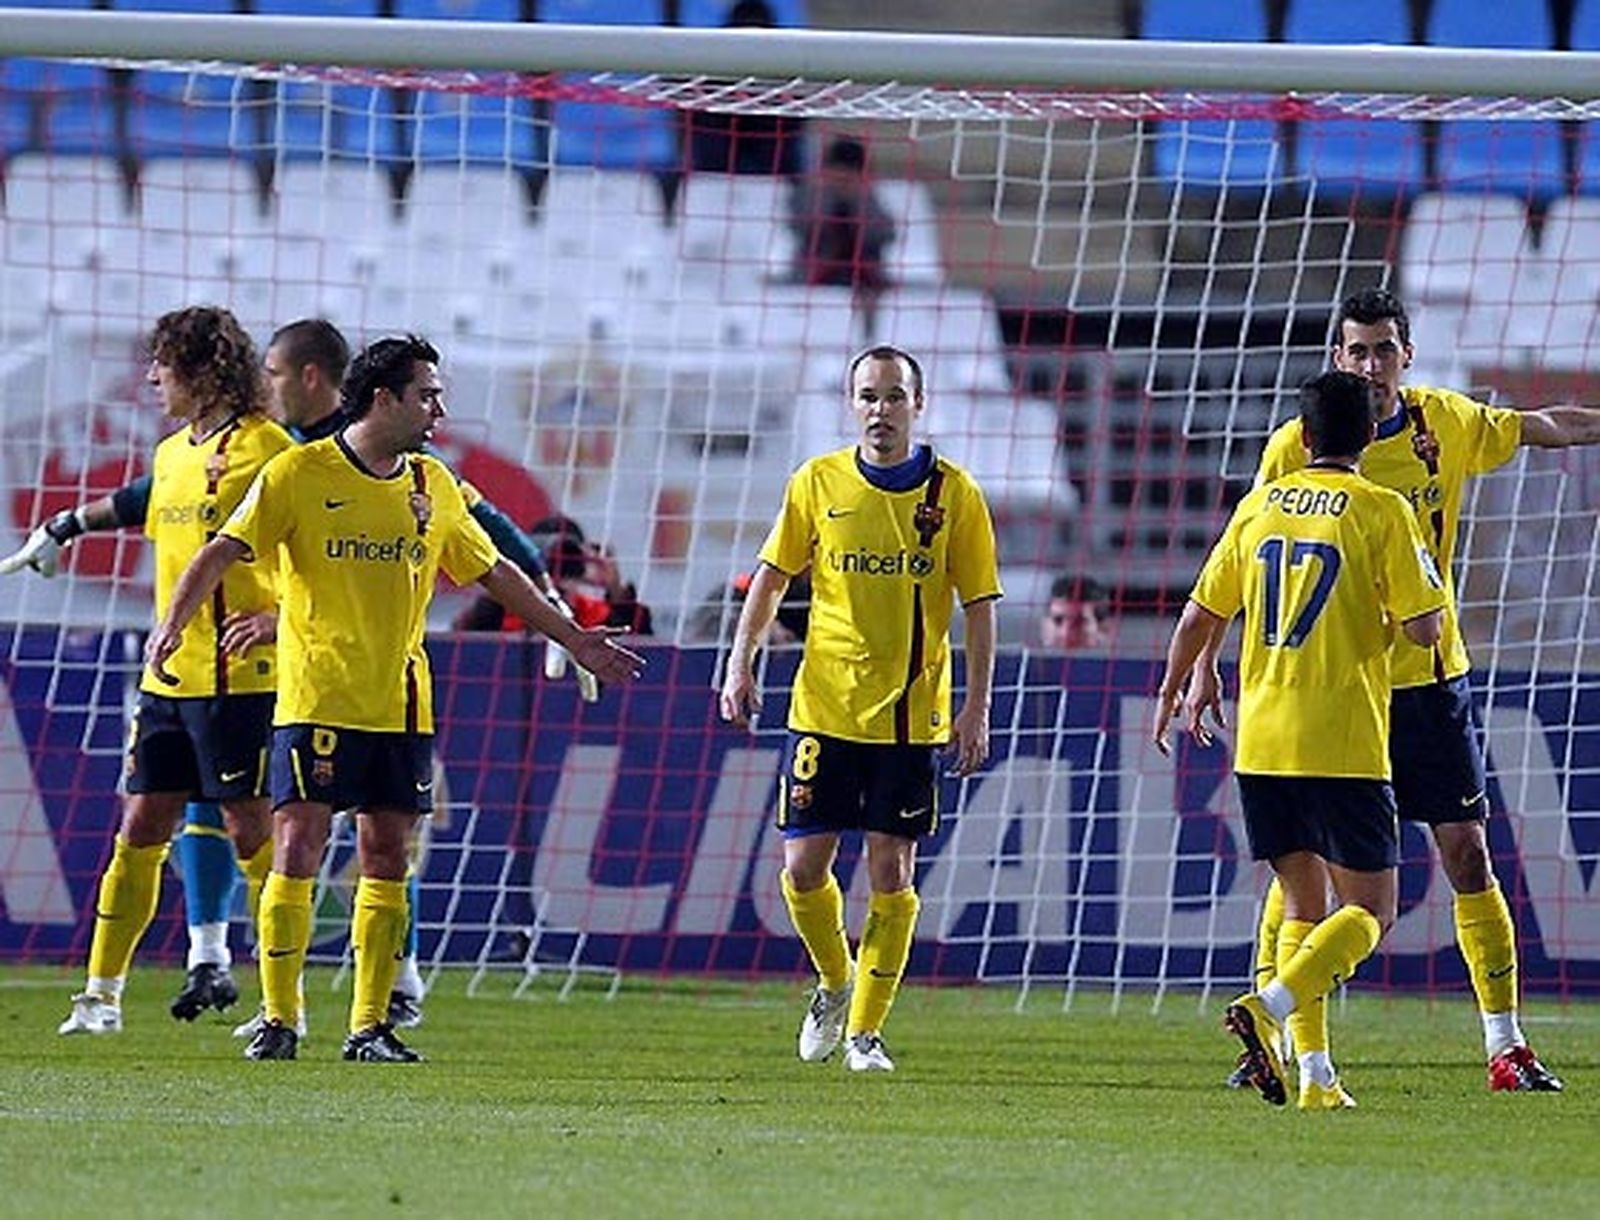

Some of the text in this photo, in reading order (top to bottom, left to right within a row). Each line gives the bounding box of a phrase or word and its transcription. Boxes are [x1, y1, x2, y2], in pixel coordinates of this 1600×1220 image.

[1264, 487, 1349, 517] PEDRO
[326, 531, 406, 562] unicef
[829, 547, 906, 575] unicef
[1255, 535, 1343, 649] 17
[793, 736, 821, 781] 8
